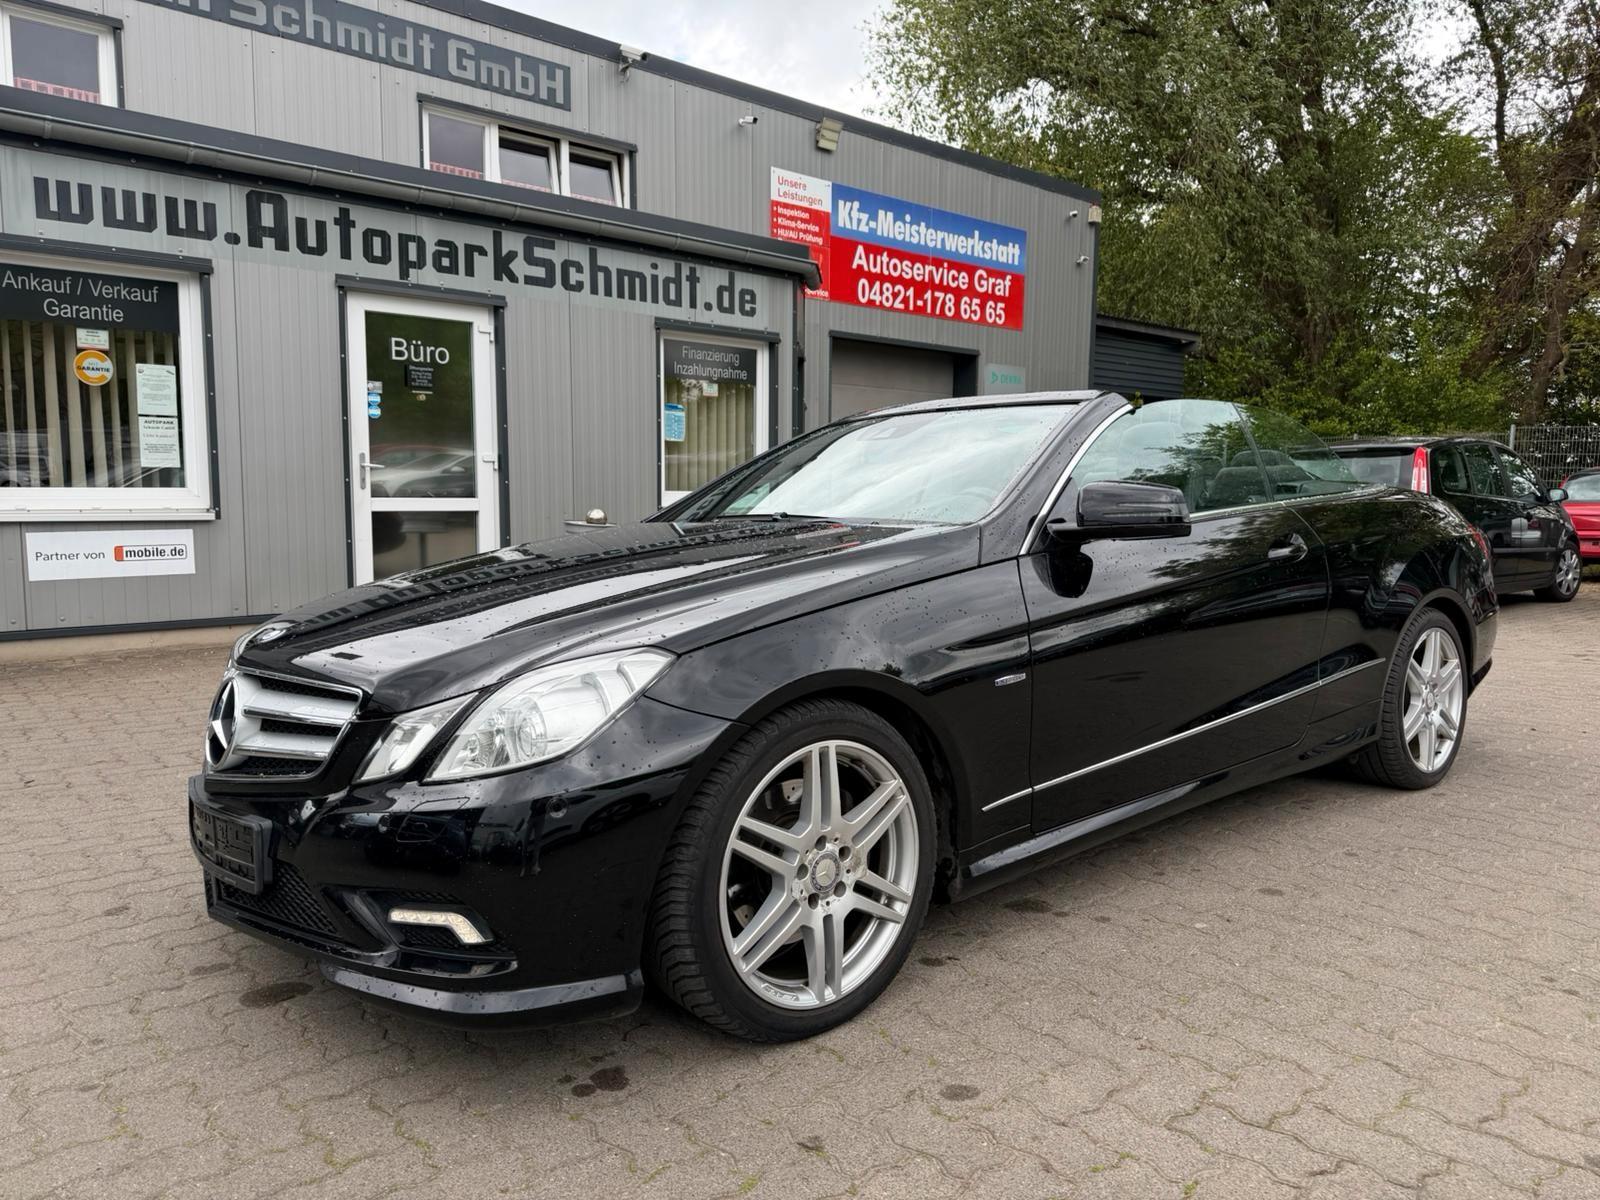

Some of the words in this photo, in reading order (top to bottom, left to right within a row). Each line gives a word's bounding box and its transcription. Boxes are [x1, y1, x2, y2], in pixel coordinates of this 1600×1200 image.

[447, 38, 564, 104] GmbH
[777, 175, 807, 191] Unsere
[777, 187, 823, 206] Leistungen
[777, 205, 810, 219] Inspektion
[777, 216, 819, 232] Klima-Service
[838, 199, 1020, 265] Kfz-Meisterwerkstatt
[33, 176, 757, 318] www.AutoparkSchmidt.de
[799, 232, 823, 245] Prüfung
[852, 245, 969, 289] Autoservice
[974, 269, 1012, 297] Graf
[2, 270, 72, 294] Ankauf
[77, 277, 83, 295] /
[88, 278, 159, 303] Verkauf
[43, 298, 124, 322] Garantie
[857, 278, 955, 317] 04821-178
[960, 296, 981, 321] 65
[985, 302, 1006, 325] 65
[391, 336, 450, 365] Büro
[682, 345, 740, 366] Finanzierung
[76, 365, 110, 373] GARANTIE
[673, 361, 748, 380] Inzahlungnahme
[35, 551, 80, 561] Partner
[83, 551, 105, 560] von
[125, 546, 184, 558] mobile.de
